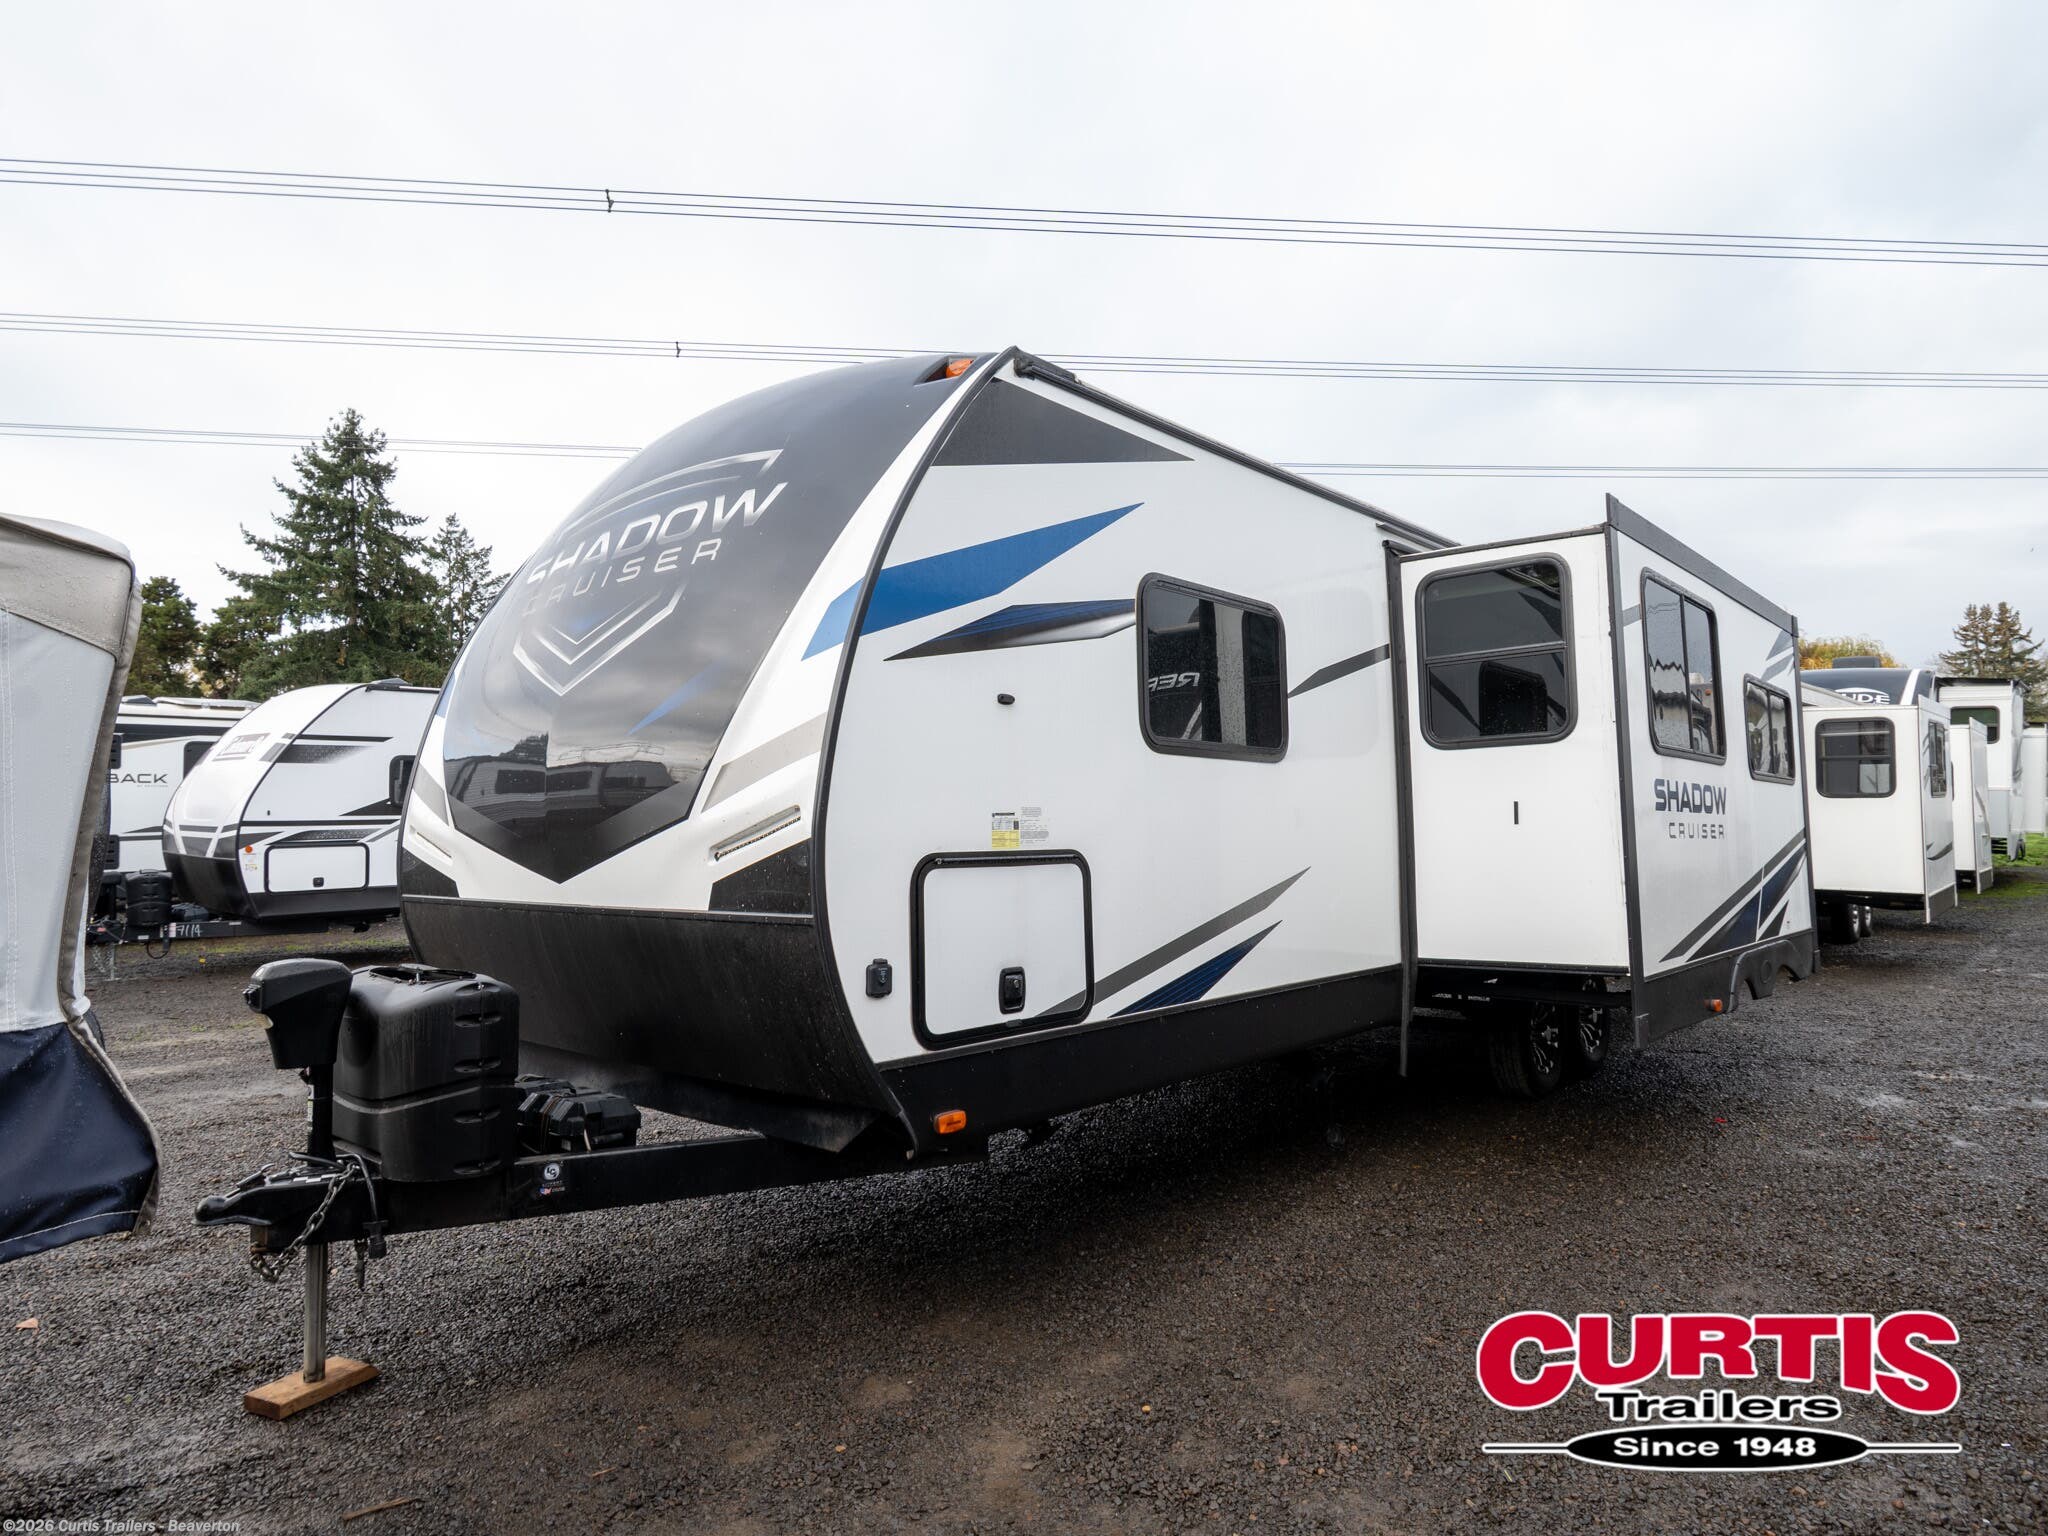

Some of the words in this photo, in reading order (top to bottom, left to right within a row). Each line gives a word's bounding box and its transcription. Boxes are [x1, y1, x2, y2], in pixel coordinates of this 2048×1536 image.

[526, 482, 788, 585] SHADOW
[106, 773, 168, 784] BACK
[1653, 778, 1727, 815] SHADOW
[1668, 822, 1725, 839] CRUISER
